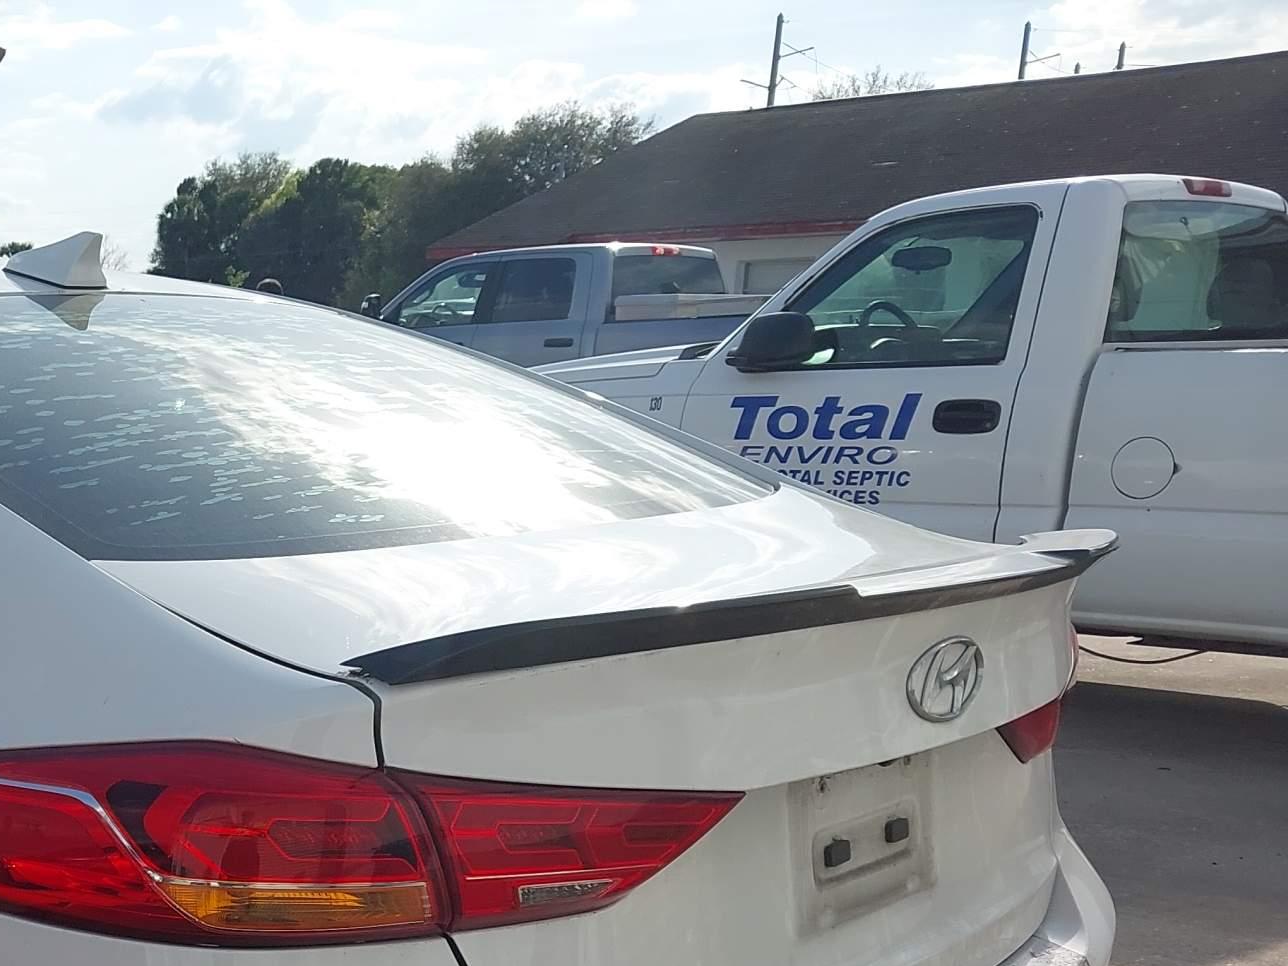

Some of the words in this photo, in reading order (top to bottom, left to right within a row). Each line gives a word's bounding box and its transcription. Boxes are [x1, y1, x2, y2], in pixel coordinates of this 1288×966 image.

[730, 392, 923, 441] Total
[739, 446, 899, 466] ENVIRO
[832, 470, 912, 487] SEPTIC
